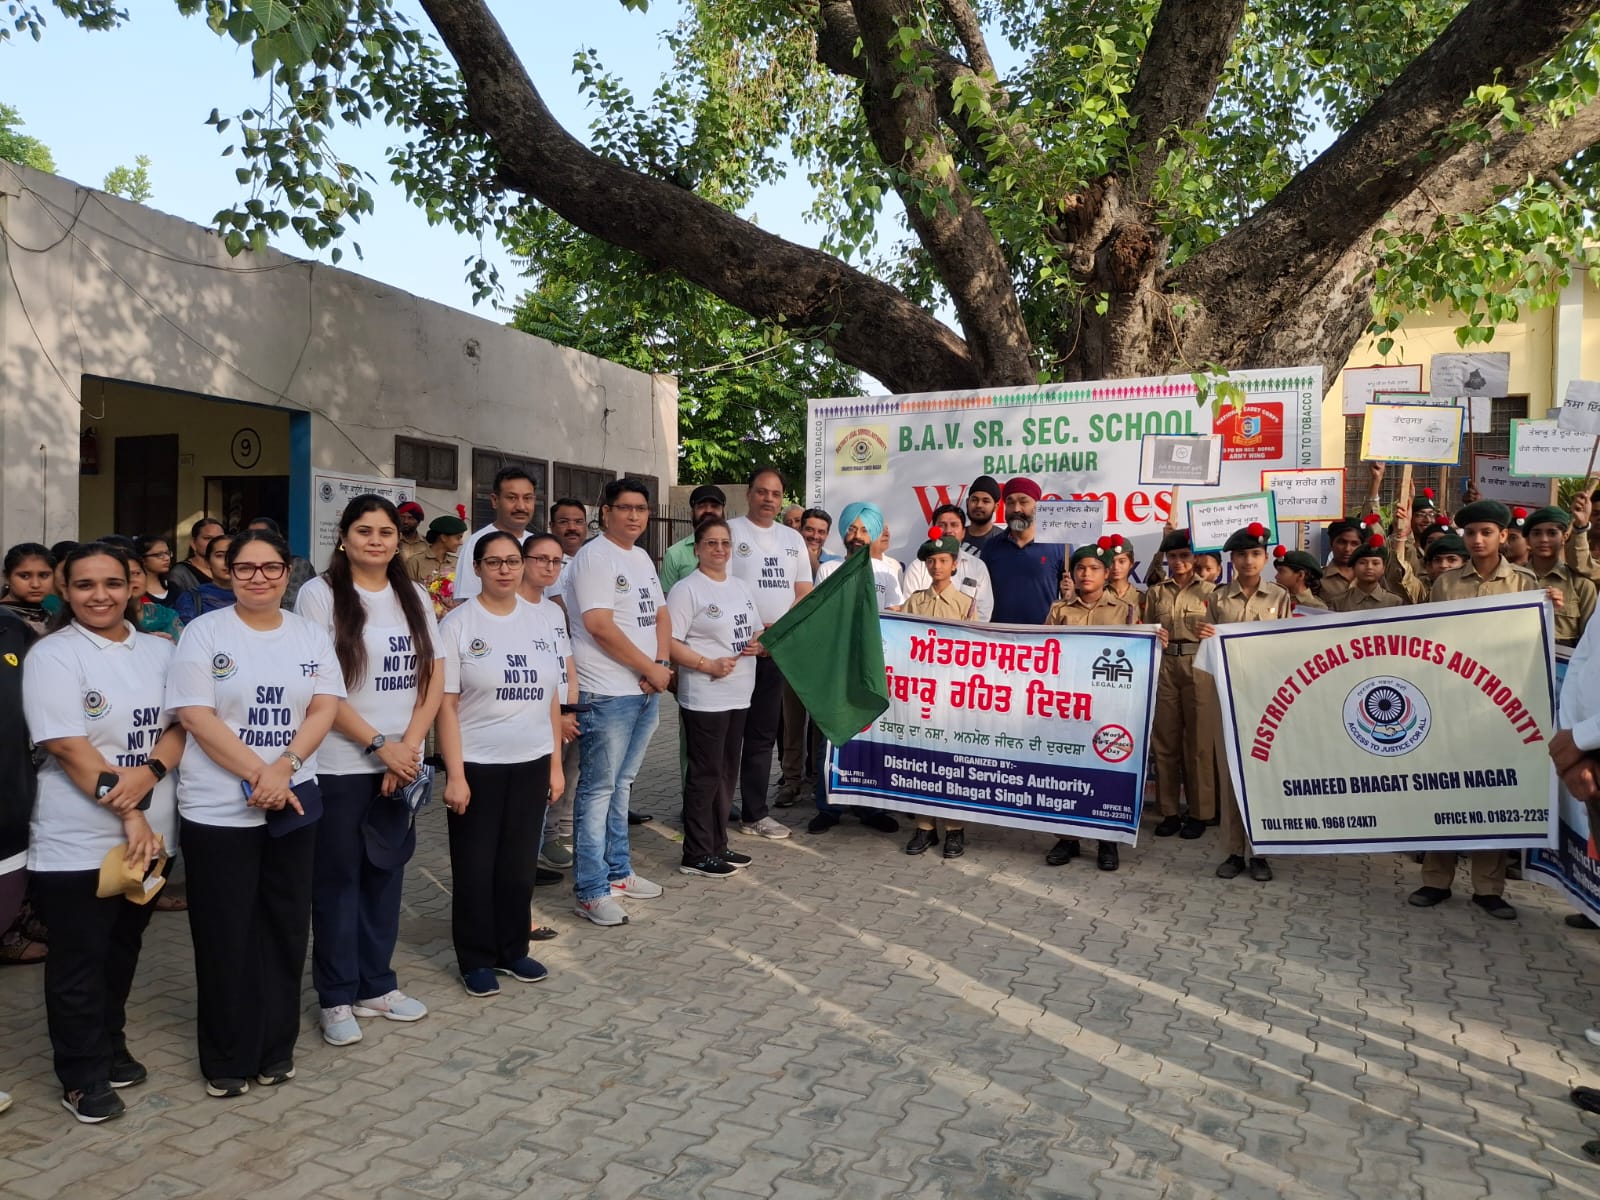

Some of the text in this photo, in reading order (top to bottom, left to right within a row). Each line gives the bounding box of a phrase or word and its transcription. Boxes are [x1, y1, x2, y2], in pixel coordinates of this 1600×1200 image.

[899, 423, 964, 452] B.A.V.
[973, 420, 1012, 448] SR.
[1022, 415, 1078, 445] SEC.
[1088, 409, 1199, 443] SCHOOL
[1302, 392, 1312, 465] NO TO TOBACCO
[240, 438, 252, 457] 9
[815, 459, 821, 469] TO
[983, 450, 1098, 476] BALACHAUR
[815, 470, 821, 482] NO
[764, 556, 778, 567] SAY
[761, 567, 785, 578] NO TO
[733, 613, 747, 626] SAY
[733, 625, 752, 640] NO TO
[388, 635, 412, 653] SAY
[909, 629, 1062, 676] ਅੰਤਰਰਾਸ਼ਟਰੀ
[383, 654, 417, 672] NO TO
[506, 654, 528, 667] SAY
[504, 669, 538, 684] NO TO
[1091, 680, 1132, 690] LEGAL AID
[256, 685, 285, 704] SAY
[495, 687, 544, 701] TOBACCO
[950, 673, 1012, 713] ਰਹਿਤ
[1026, 678, 1093, 722] ਦਿਵਸ
[1250, 634, 1545, 763] DISTRICT LEGAL SERVICES AUTHORITY
[132, 706, 160, 727] SAY
[248, 707, 292, 726] NO TO
[127, 730, 145, 751] NO
[879, 716, 905, 740] ਤੰਬਾਕੂ
[909, 725, 921, 737] ਦਾ
[953, 728, 991, 747] ਅਨਮੋਲ
[995, 731, 1024, 750] ਜੀਵਨ
[1029, 735, 1042, 752] ਦੀ
[1347, 717, 1427, 753] ACCESS TO JUSTICE FOR ALL
[953, 754, 998, 768] ORGANIZED
[884, 755, 1095, 797] District Legal Services Authority,
[1282, 768, 1518, 797] SHAHEED BHAGAT SINGH NAGAR
[890, 774, 1078, 812] Shaheed Bhagat Singh Nagar
[1102, 804, 1122, 812] OFFICE
[1261, 815, 1377, 831] TOLL FREE NO. 1968 (24X7)
[1434, 811, 1469, 825] OFFICE
[1469, 811, 1487, 824] NO.
